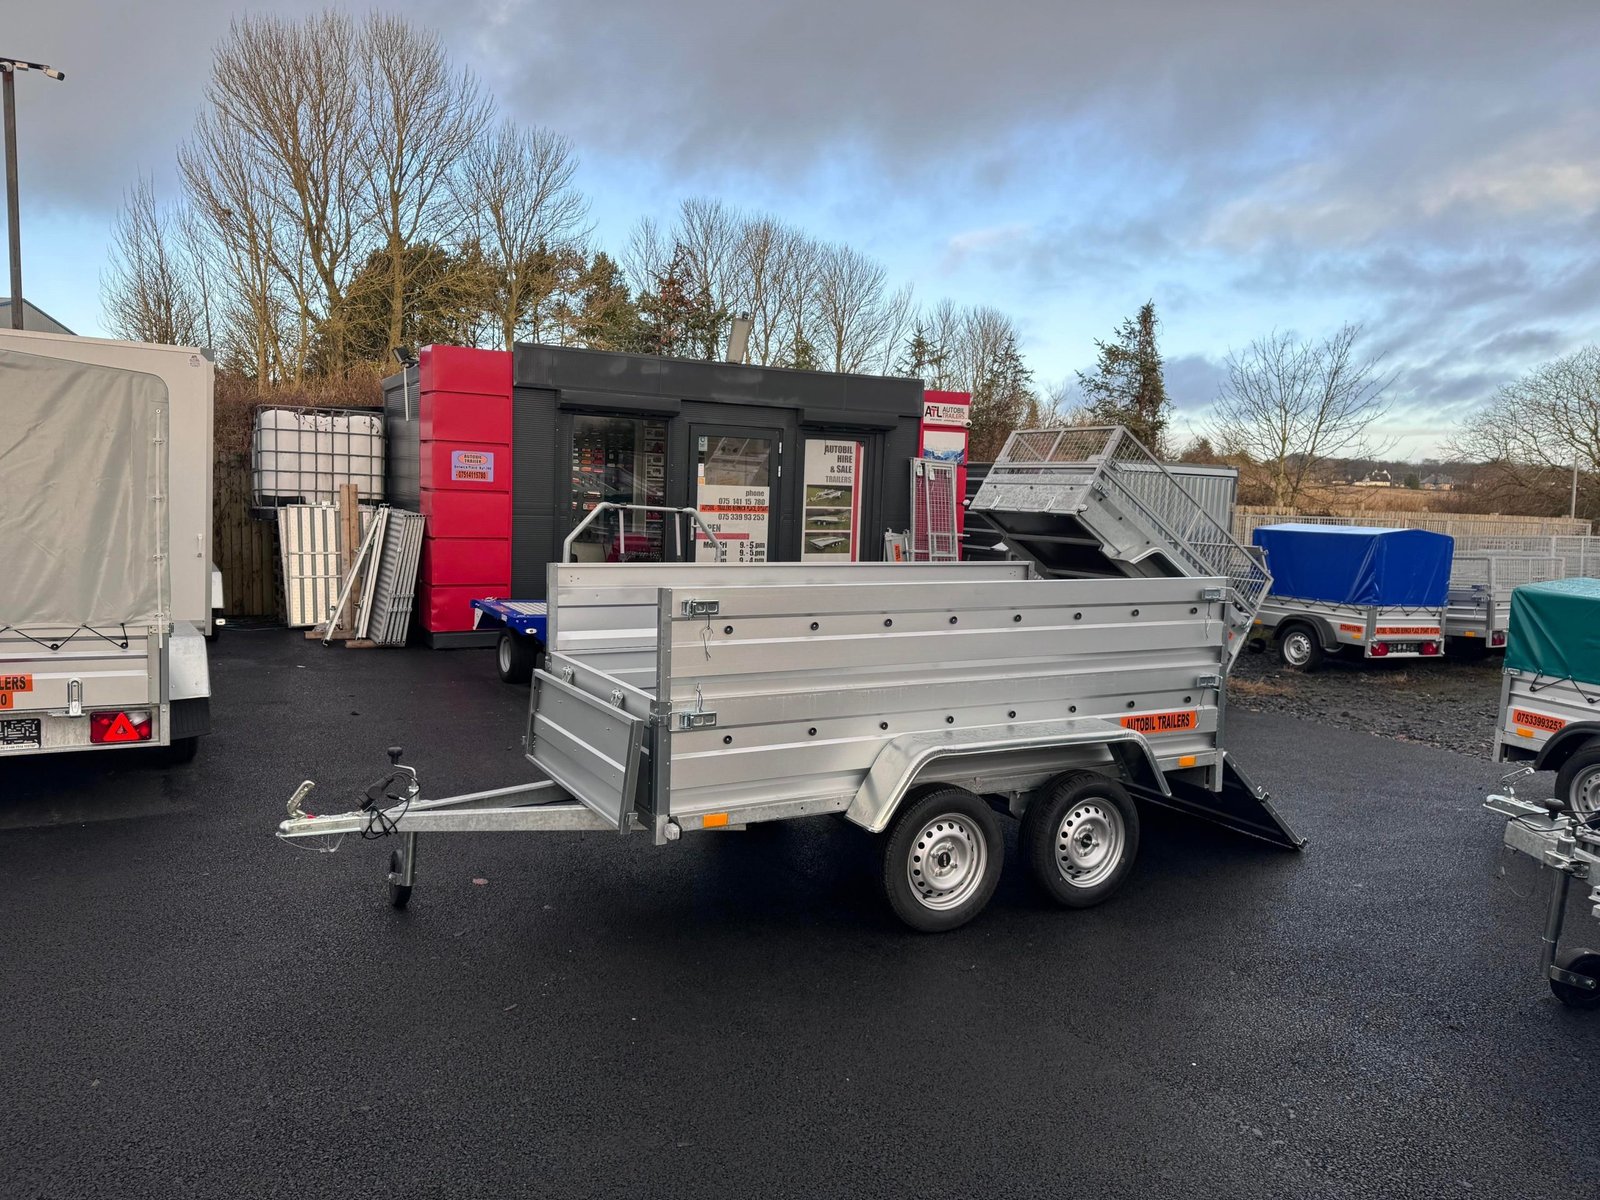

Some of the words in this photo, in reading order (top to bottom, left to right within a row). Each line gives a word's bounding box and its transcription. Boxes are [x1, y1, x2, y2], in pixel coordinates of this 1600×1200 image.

[825, 445, 853, 454] AUTOBIL
[837, 455, 852, 463] HIRE
[837, 465, 852, 473] SALE
[1126, 717, 1156, 732] AUTOBIL
[1158, 713, 1190, 730] TRAILERS
[1517, 712, 1563, 731] 07533993253
